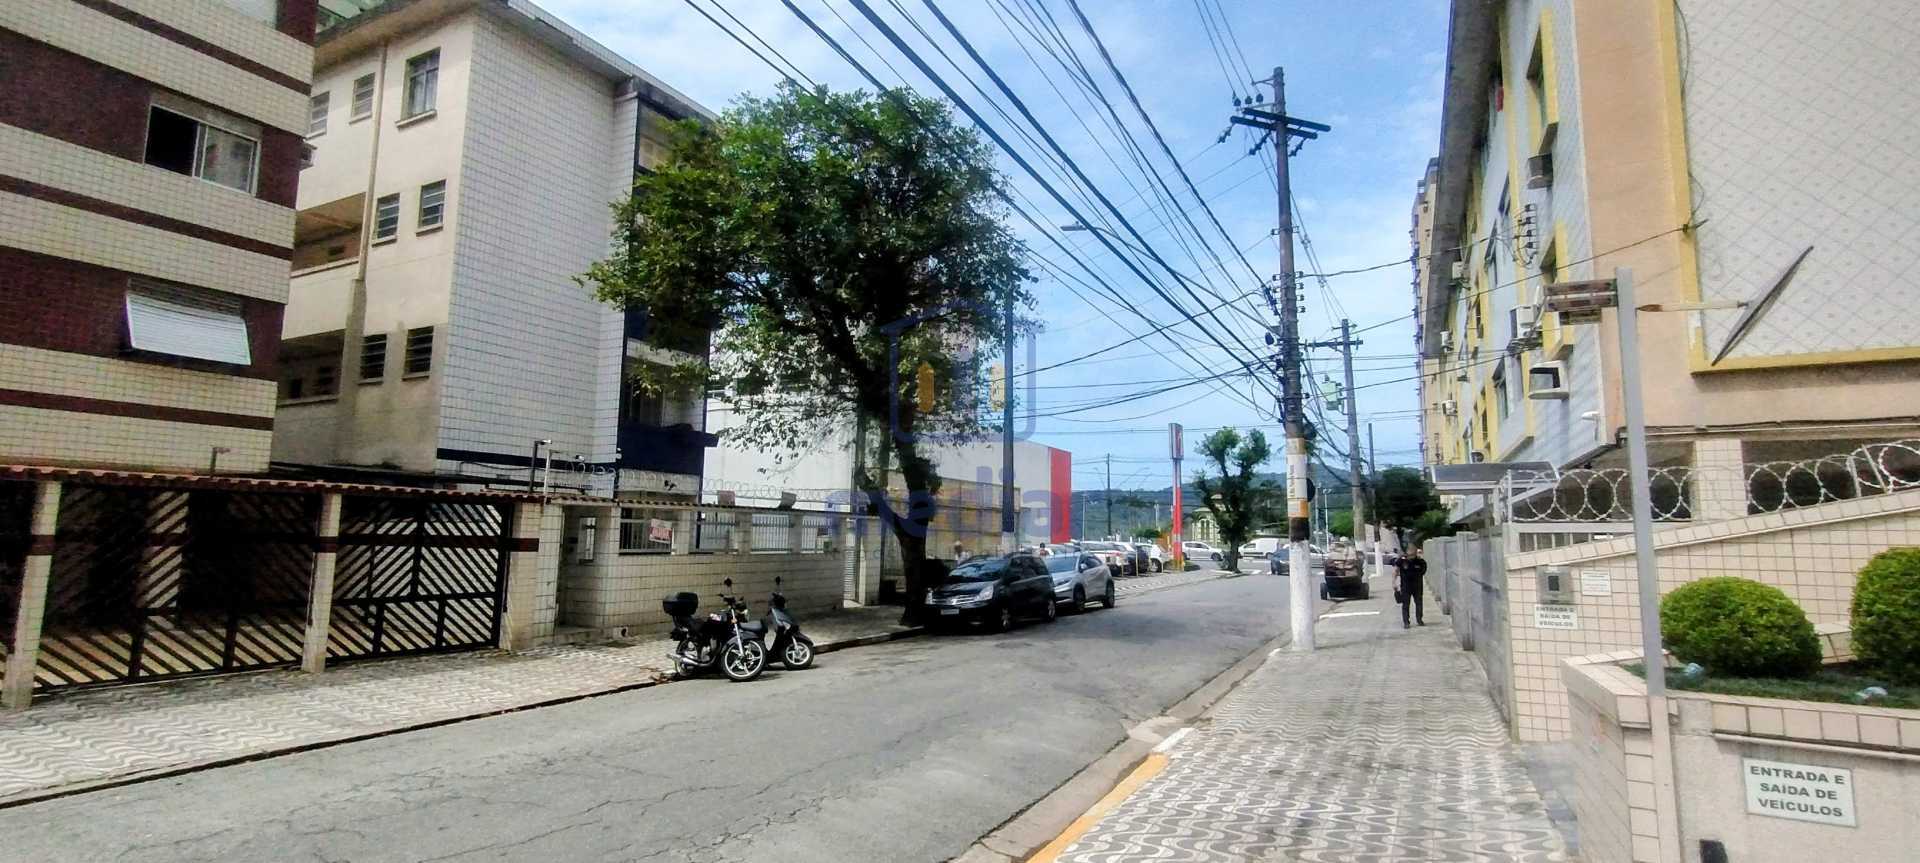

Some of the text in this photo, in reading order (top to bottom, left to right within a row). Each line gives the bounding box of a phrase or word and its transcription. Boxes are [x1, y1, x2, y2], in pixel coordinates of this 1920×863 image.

[1750, 766, 1845, 785] ENTRADA E
[1815, 789, 1837, 800] DE
